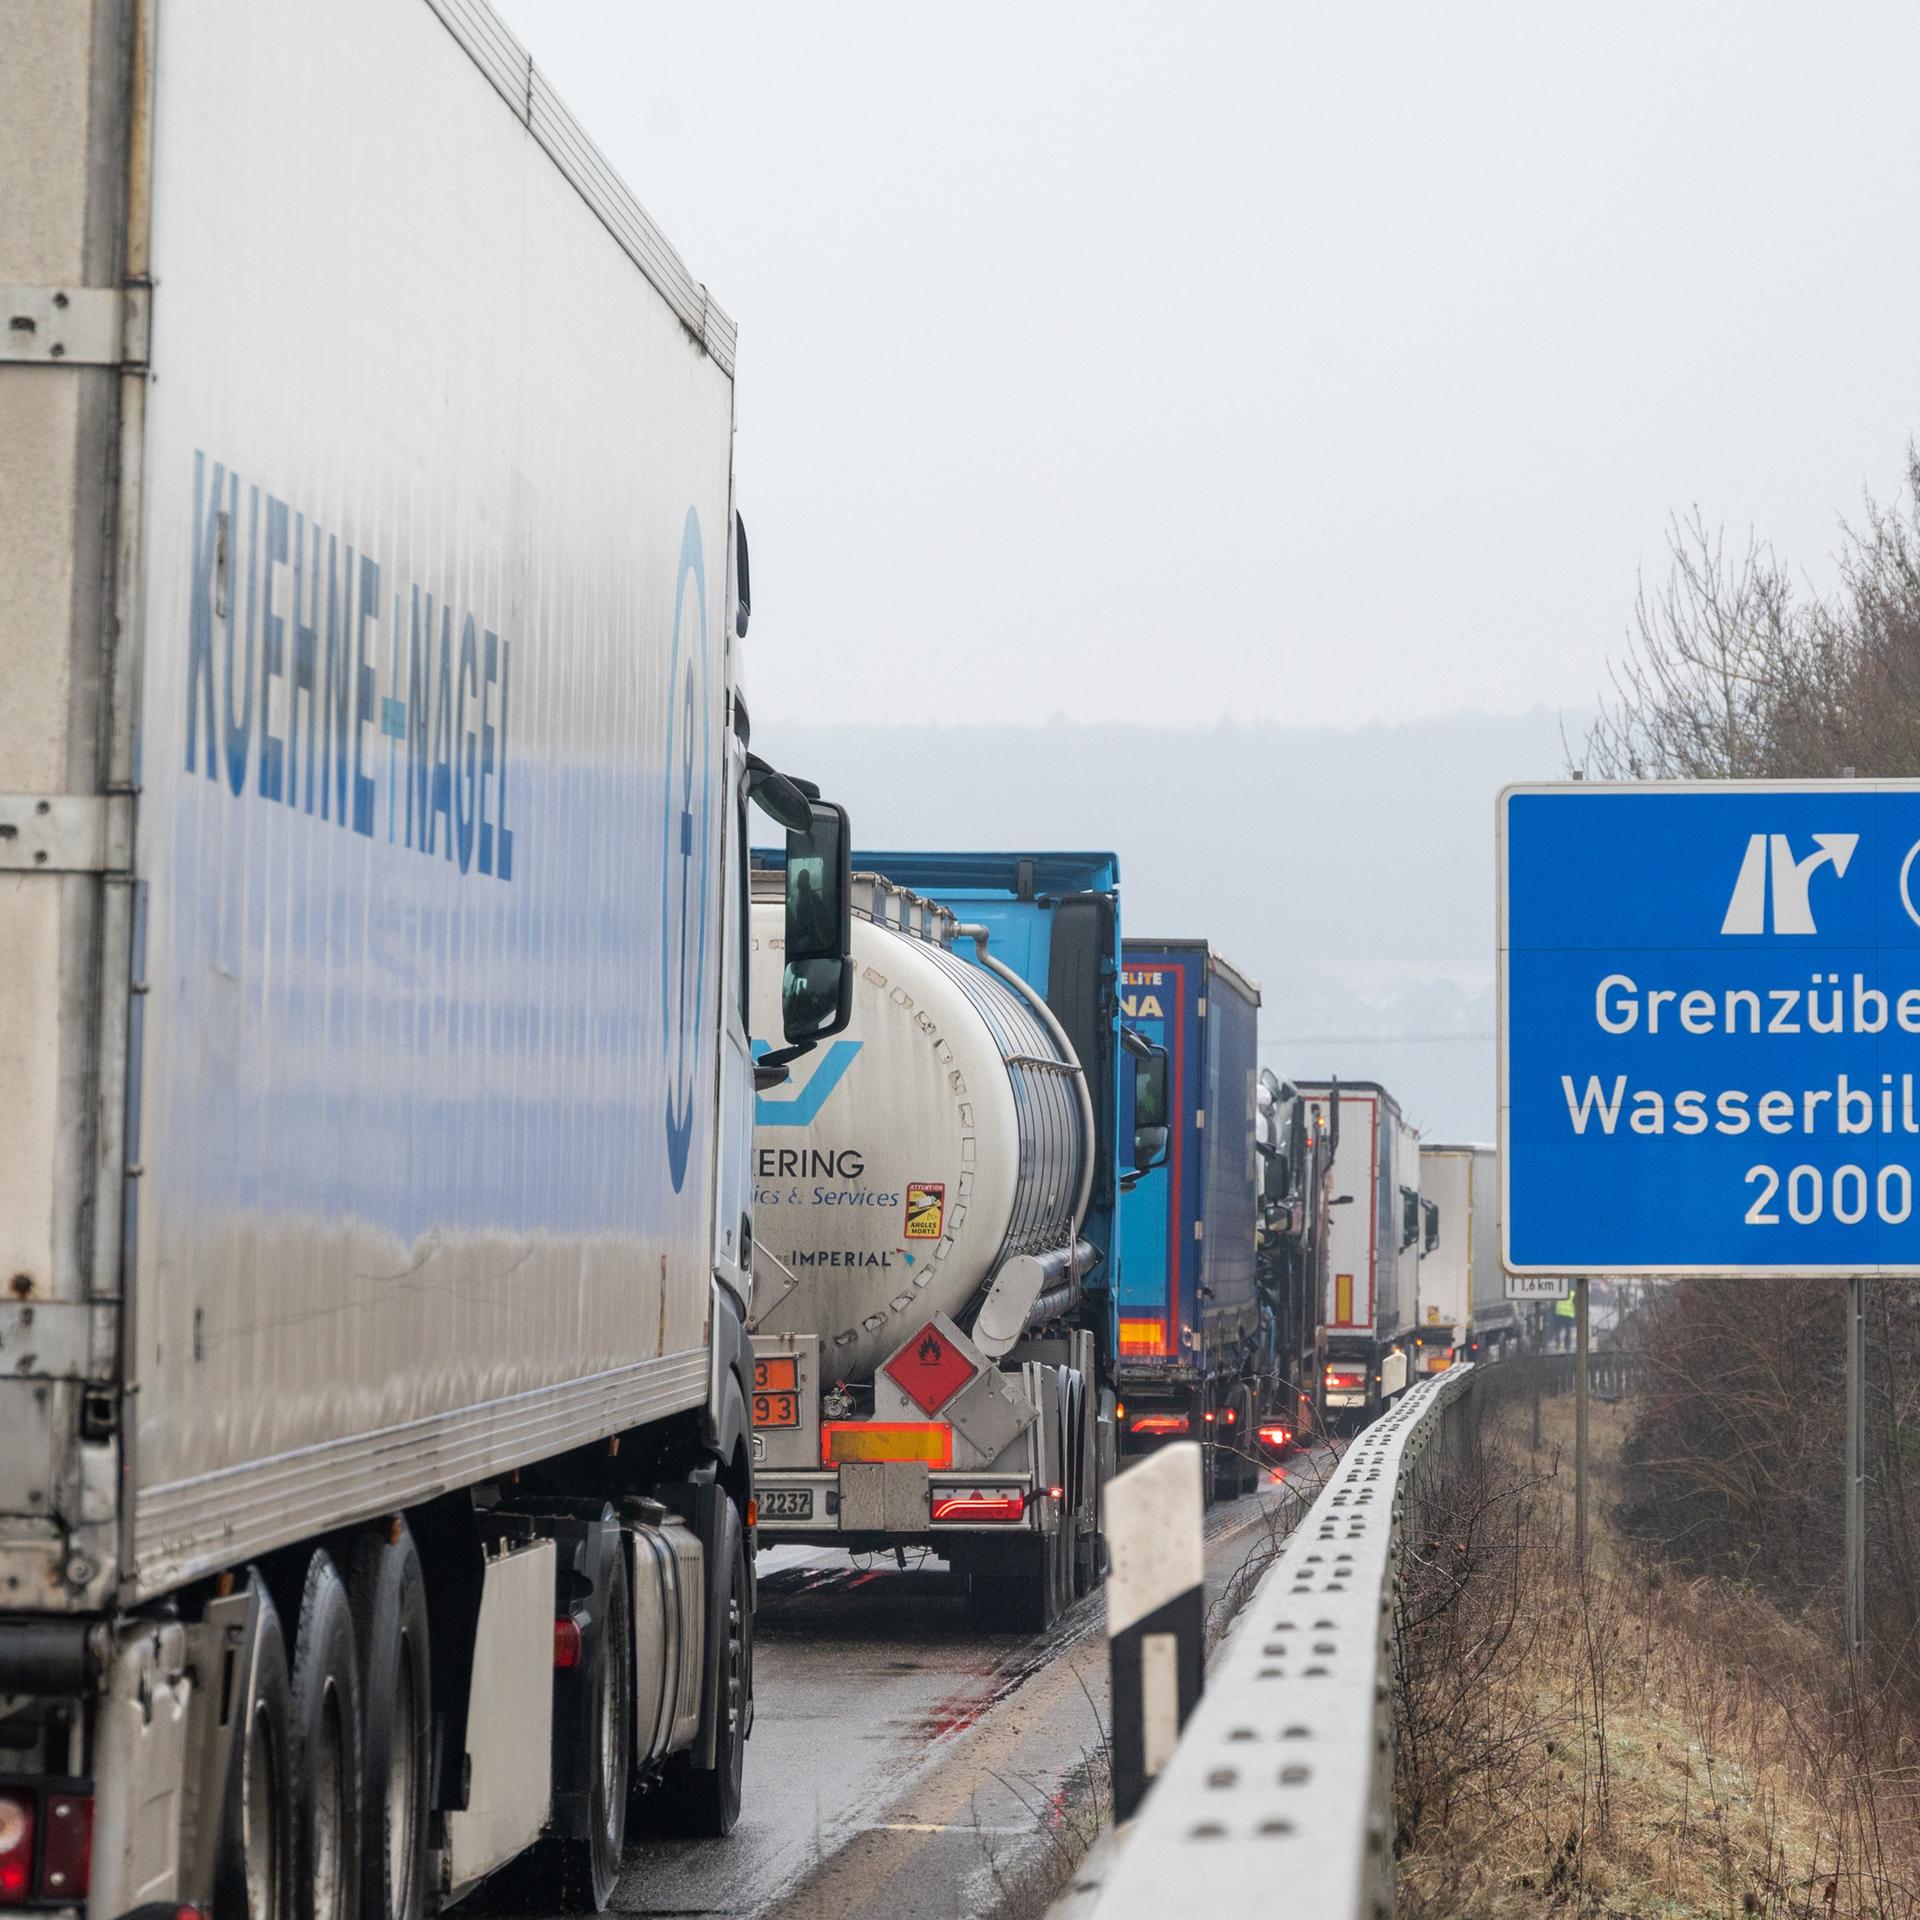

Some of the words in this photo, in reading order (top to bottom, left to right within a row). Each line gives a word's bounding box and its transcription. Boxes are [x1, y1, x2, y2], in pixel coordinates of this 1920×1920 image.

[1596, 974, 1920, 1034] Grenzübe
[1561, 1074, 1920, 1135] Wasserbil
[753, 1149, 865, 1179] ERING
[811, 1187, 899, 1207] Services
[1744, 1164, 1912, 1225] 2000
[791, 1250, 892, 1267] IMPERIAL
[1537, 1277, 1555, 1291] km
